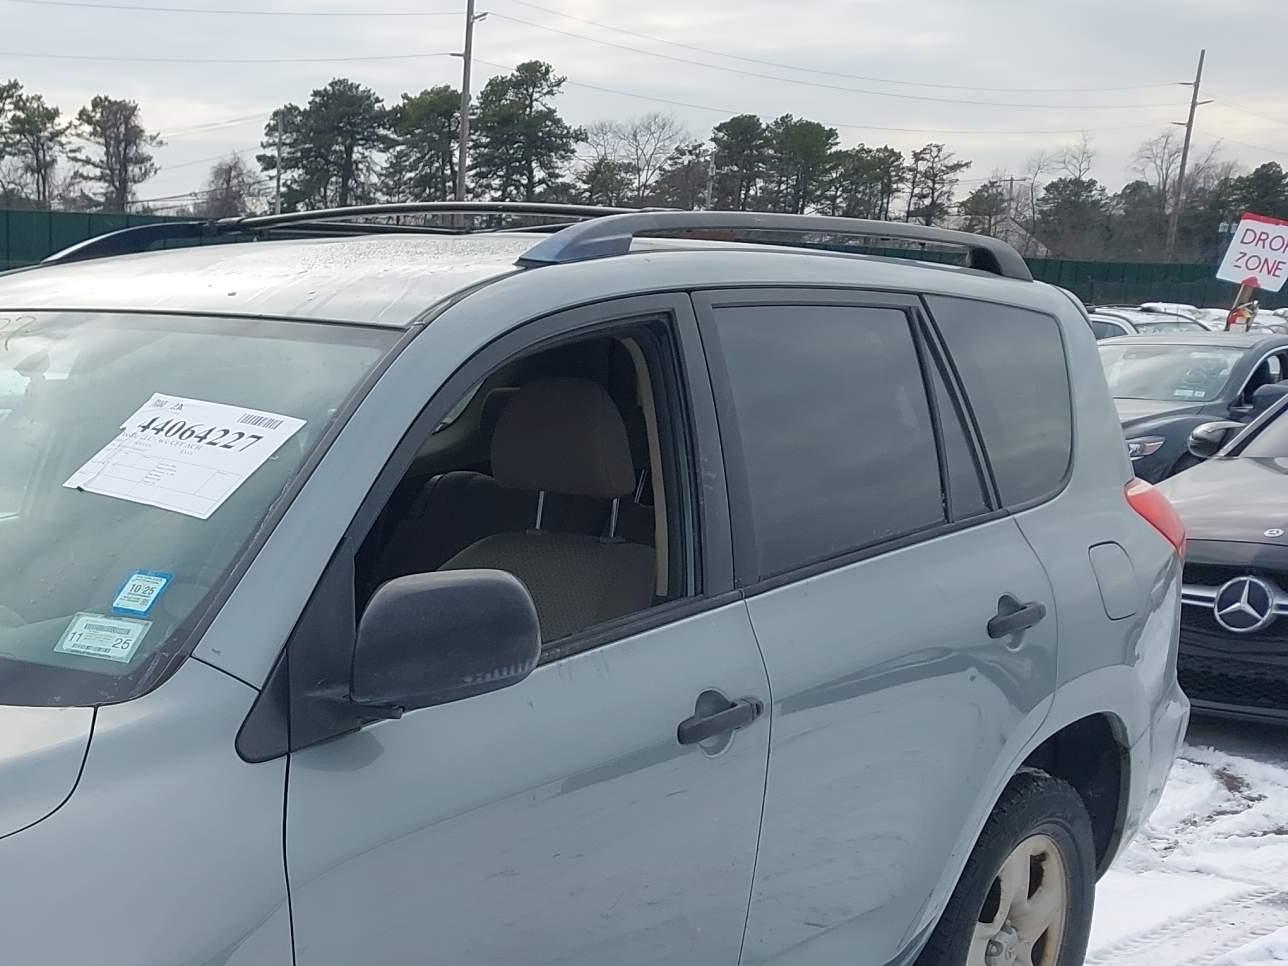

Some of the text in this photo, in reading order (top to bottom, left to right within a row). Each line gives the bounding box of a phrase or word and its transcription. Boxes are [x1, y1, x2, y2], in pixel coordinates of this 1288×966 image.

[1233, 251, 1287, 278] ZONE
[137, 416, 266, 452] 44064227
[112, 638, 132, 650] 25
